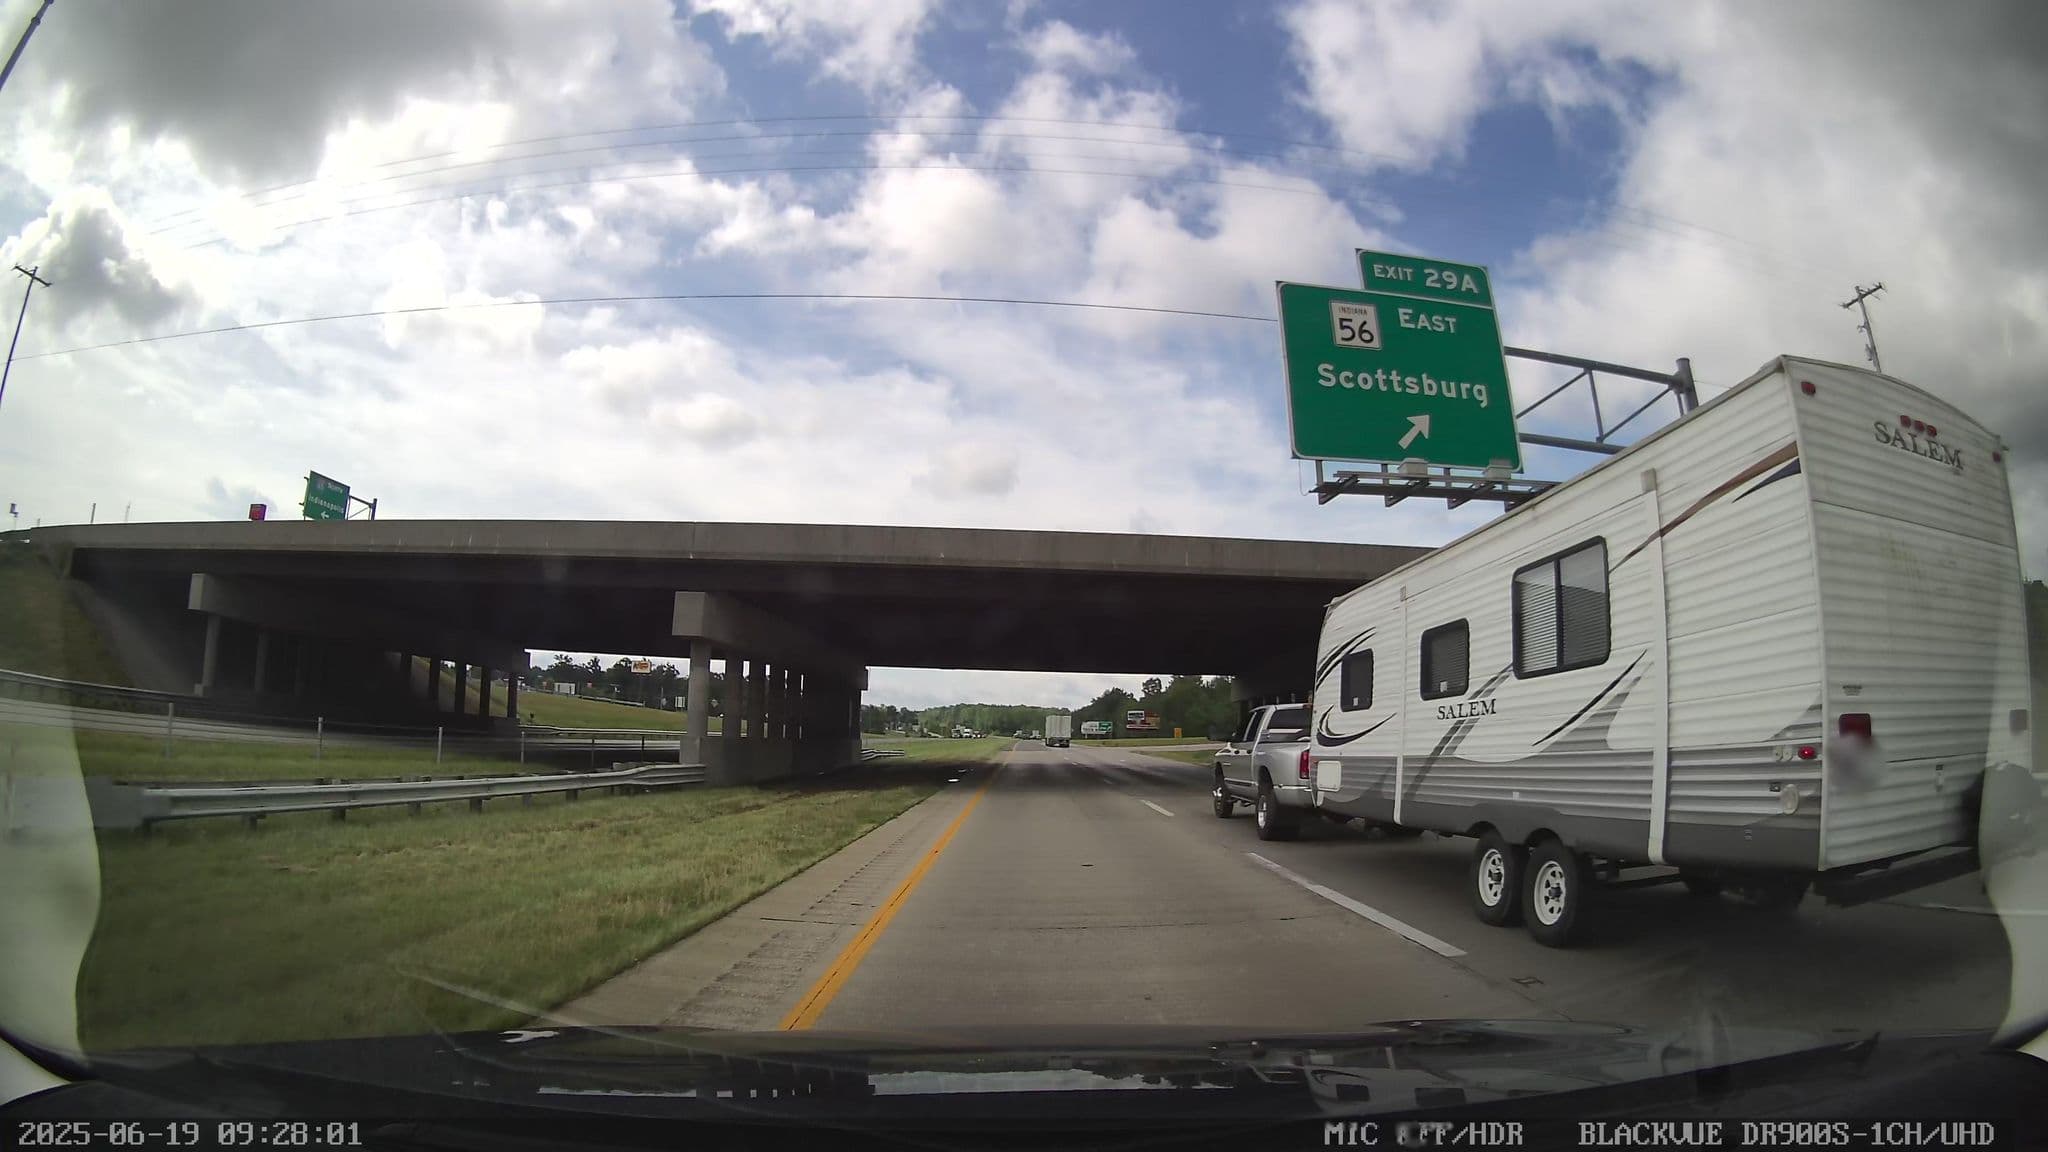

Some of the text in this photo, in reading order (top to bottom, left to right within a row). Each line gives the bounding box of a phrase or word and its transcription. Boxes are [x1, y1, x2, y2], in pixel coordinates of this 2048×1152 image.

[1373, 264, 1479, 294] EXIT 29A
[1338, 306, 1368, 316] INDIANA
[1397, 308, 1457, 334] EAST
[1338, 317, 1375, 344] 56
[1317, 363, 1489, 408] Scottsburg
[1873, 421, 1964, 471] SALEM
[1436, 698, 1497, 720] SALEM
